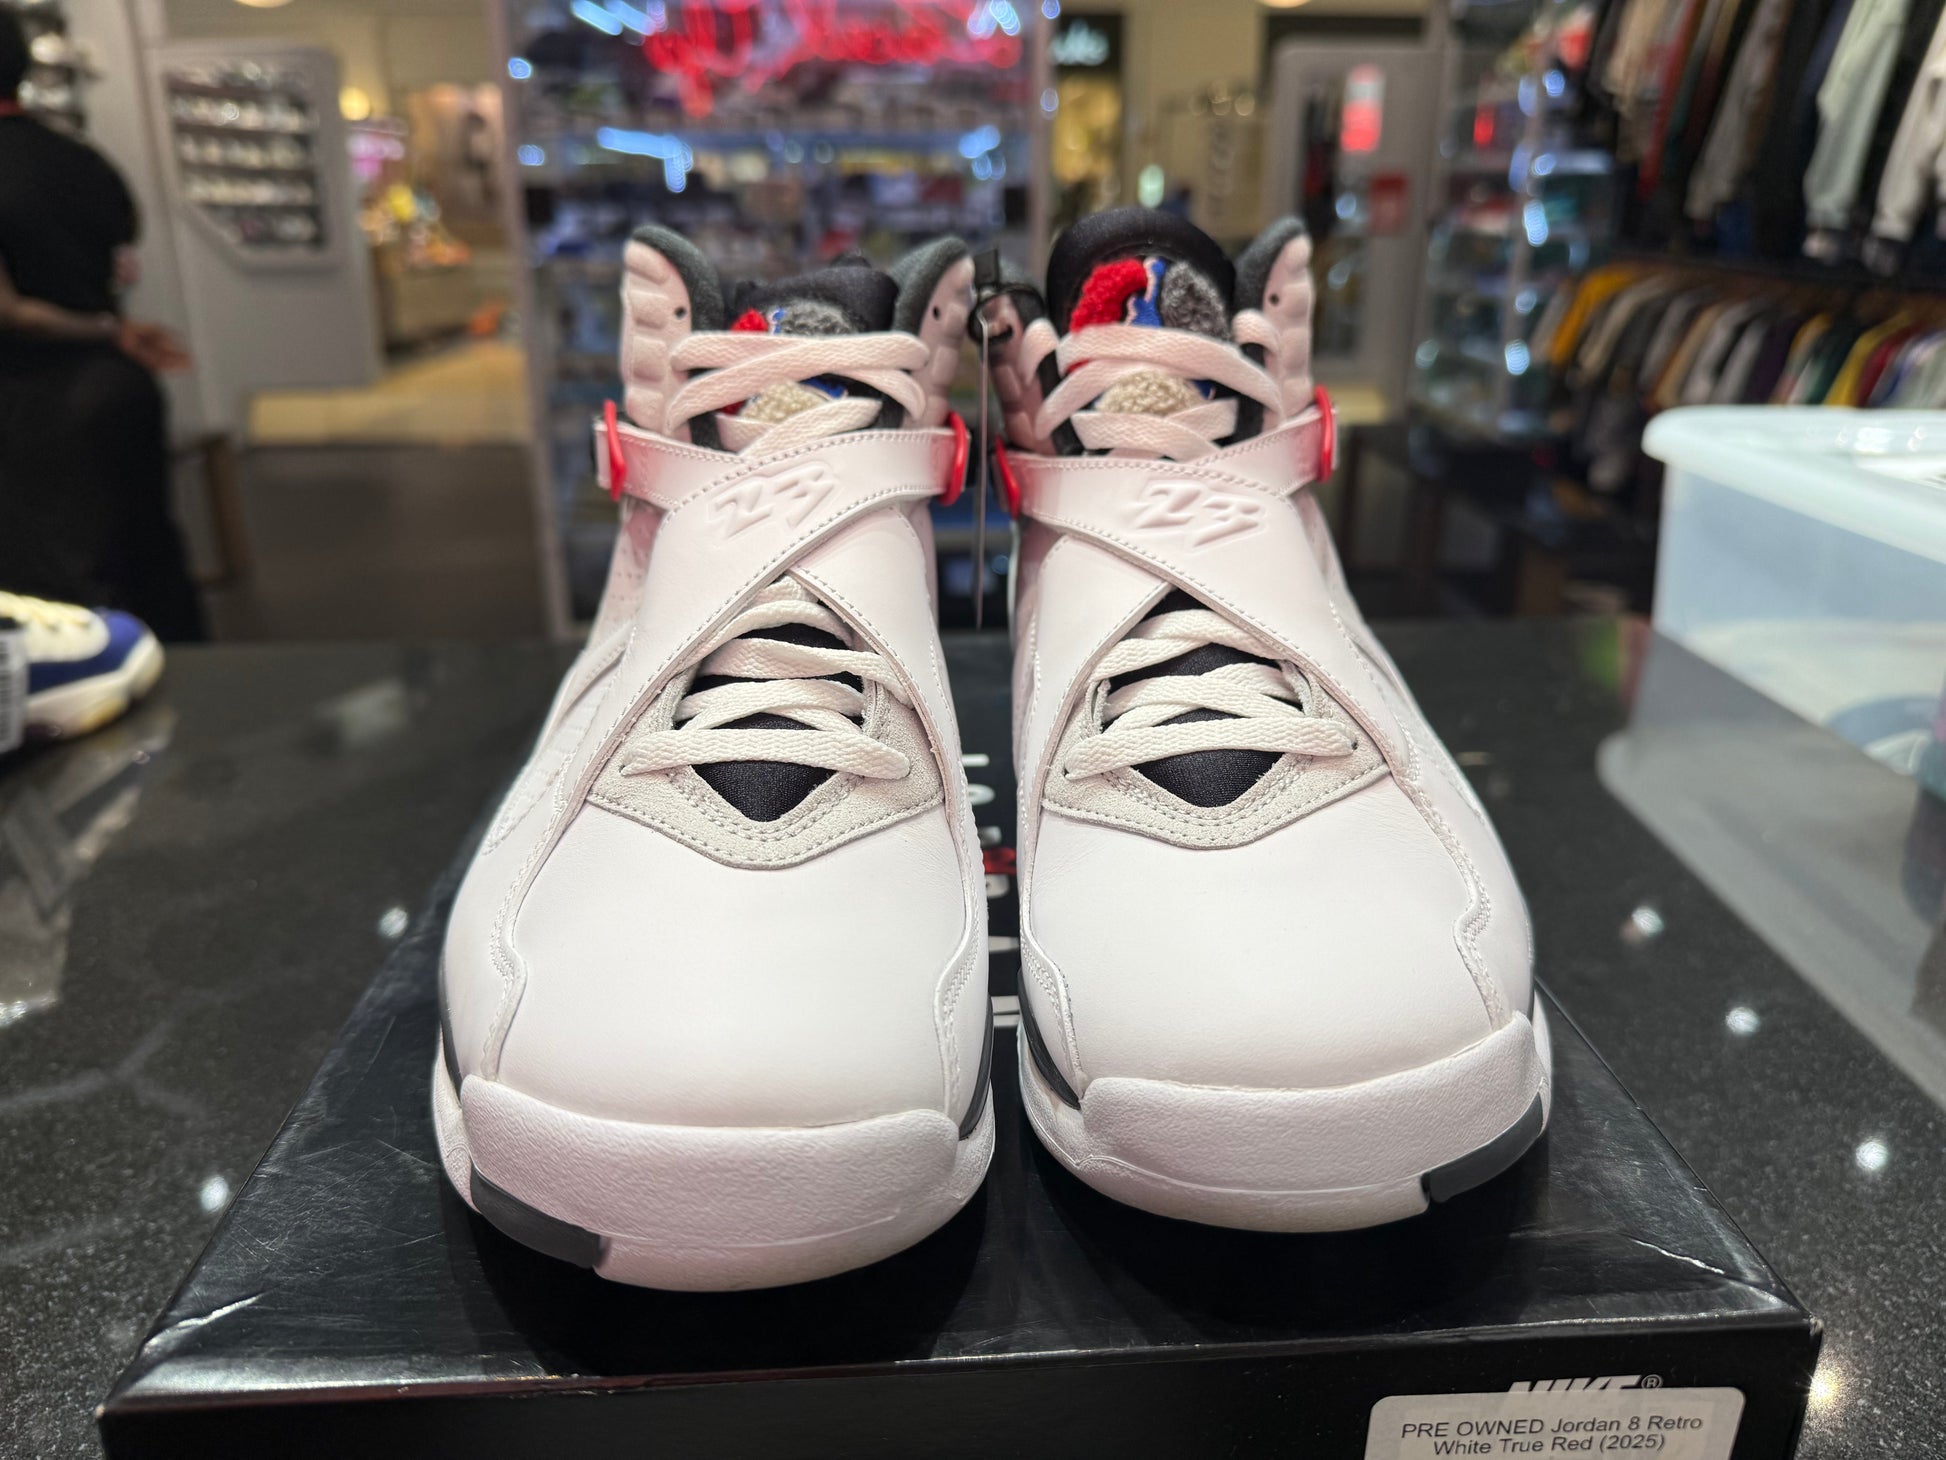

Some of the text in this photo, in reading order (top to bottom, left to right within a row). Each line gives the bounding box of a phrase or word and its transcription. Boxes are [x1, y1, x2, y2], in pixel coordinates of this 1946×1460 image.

[1401, 1414, 1703, 1439] PRE OWNED Jordan 8 Retro
[1433, 1433, 1666, 1456] White True Red (2025)
